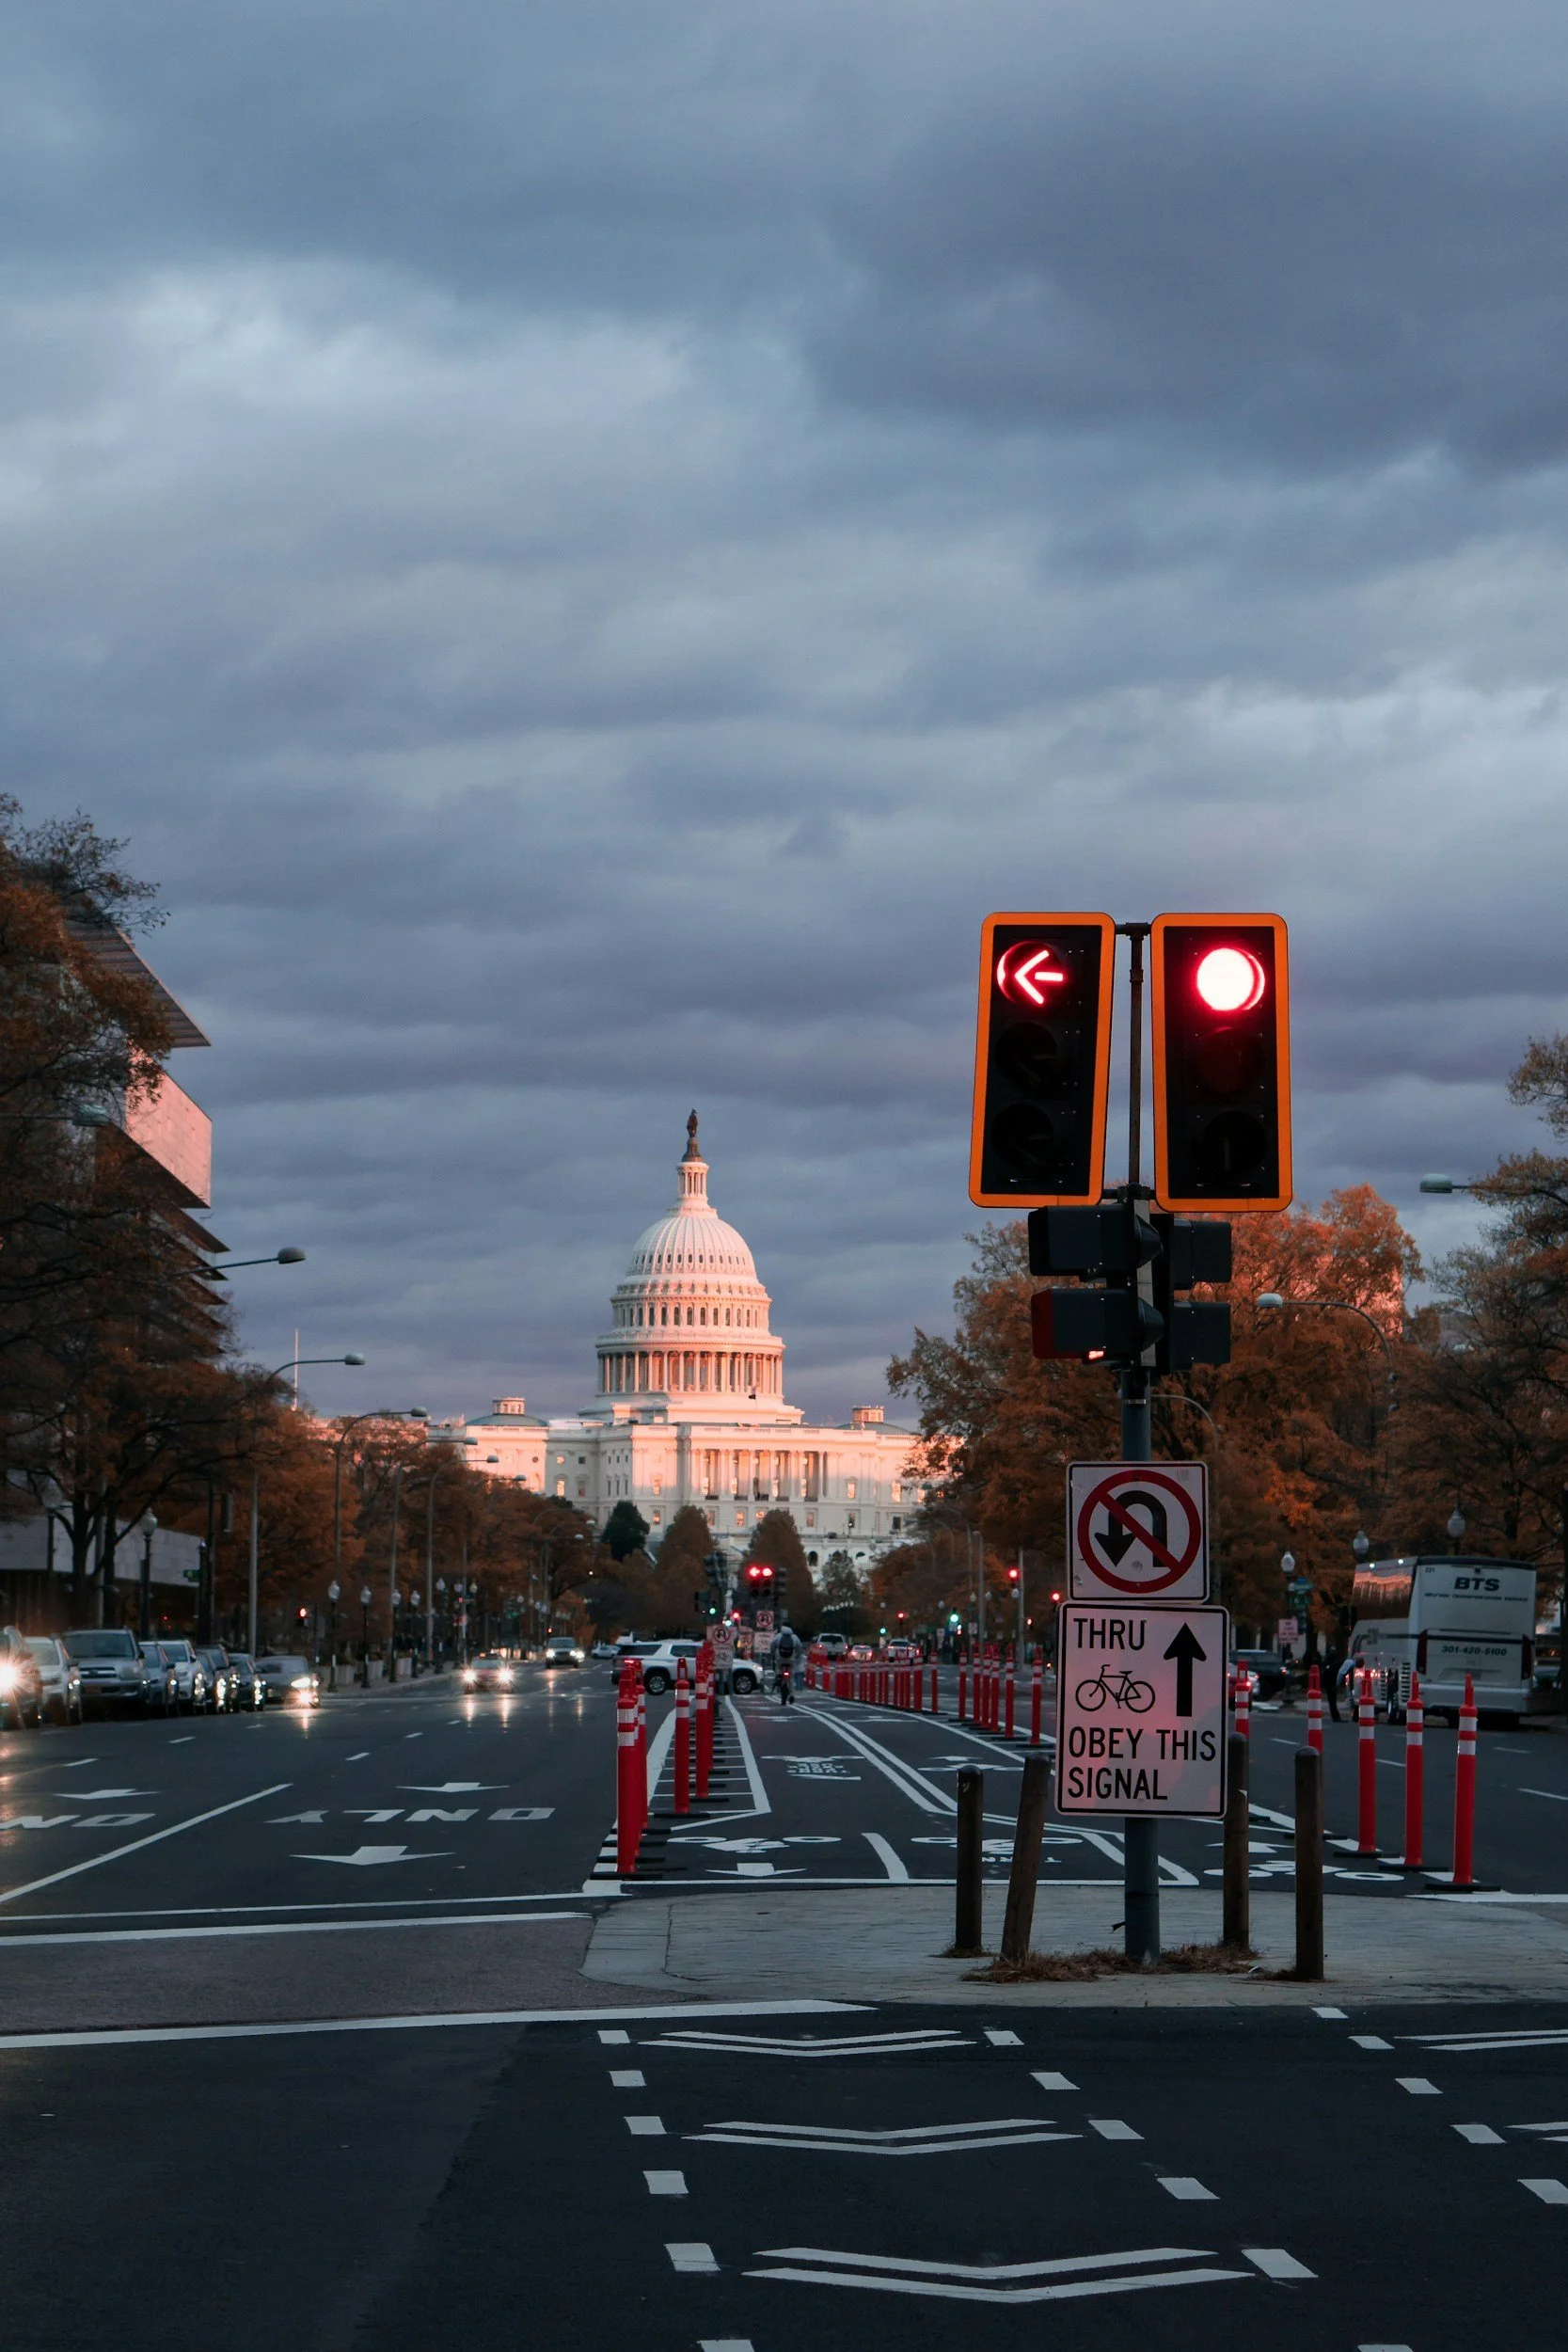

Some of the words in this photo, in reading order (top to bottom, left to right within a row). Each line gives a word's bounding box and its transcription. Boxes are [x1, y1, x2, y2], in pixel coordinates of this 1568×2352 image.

[1454, 1577, 1500, 1591] BTS
[1073, 1618, 1146, 1651] THRU
[1441, 1645, 1508, 1656] 301-420-5100
[1069, 1726, 1144, 1759] OBEY
[1156, 1729, 1216, 1762] THIS
[1068, 1767, 1168, 1801] SIGNAL
[262, 1807, 556, 1823] ONLY
